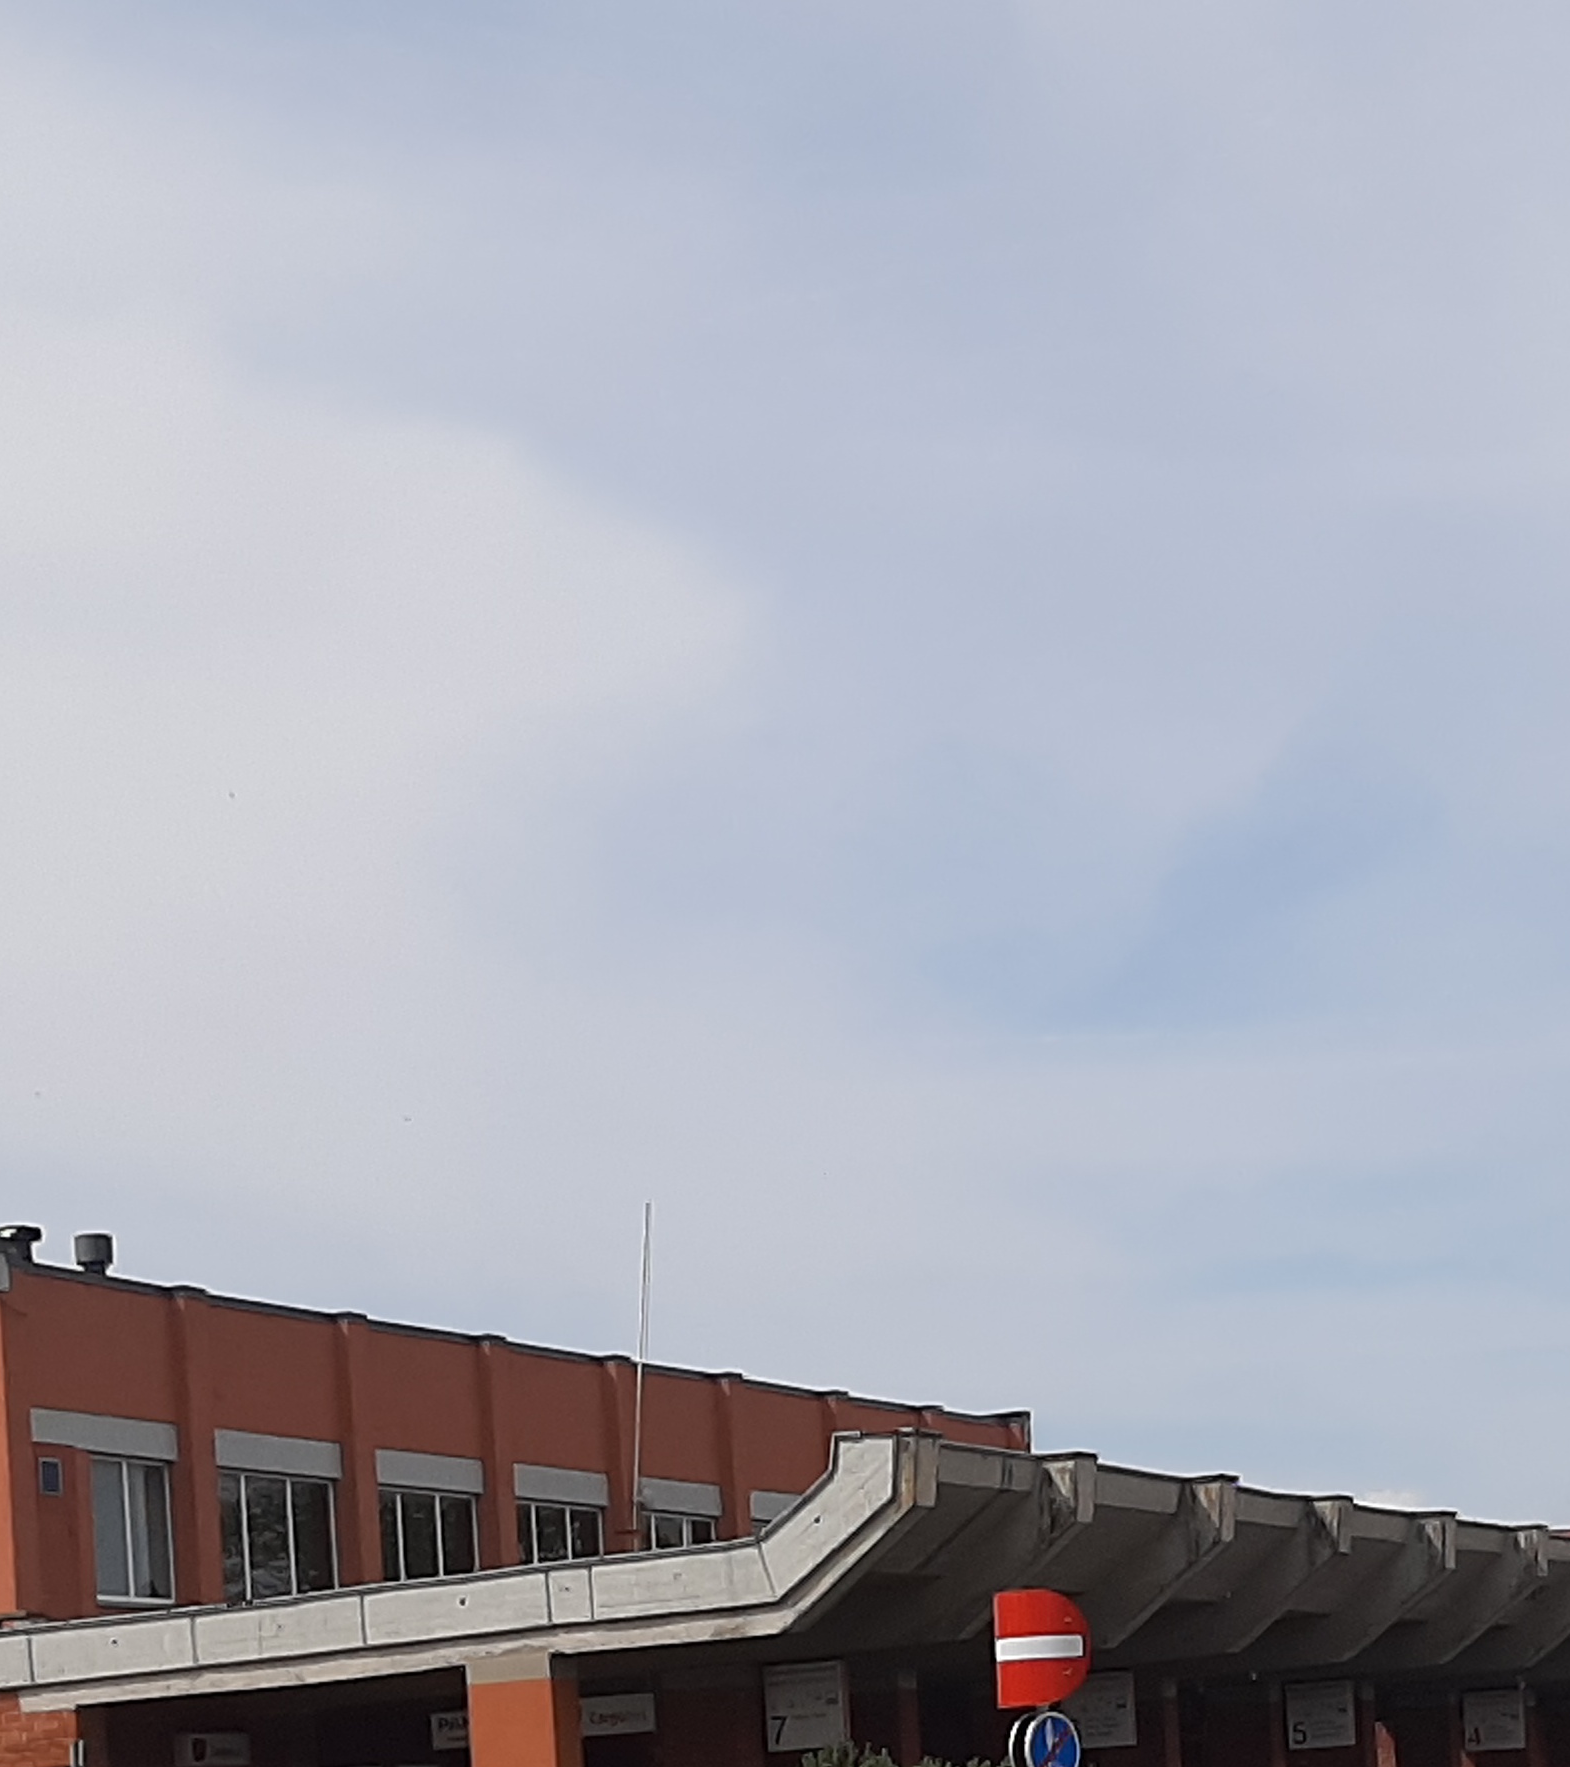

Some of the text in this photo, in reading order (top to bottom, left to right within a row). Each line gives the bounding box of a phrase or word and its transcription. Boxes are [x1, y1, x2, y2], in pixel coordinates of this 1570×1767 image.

[770, 1715, 788, 1745] 7
[1293, 1721, 1307, 1745] 5
[1467, 1727, 1481, 1745] 4
